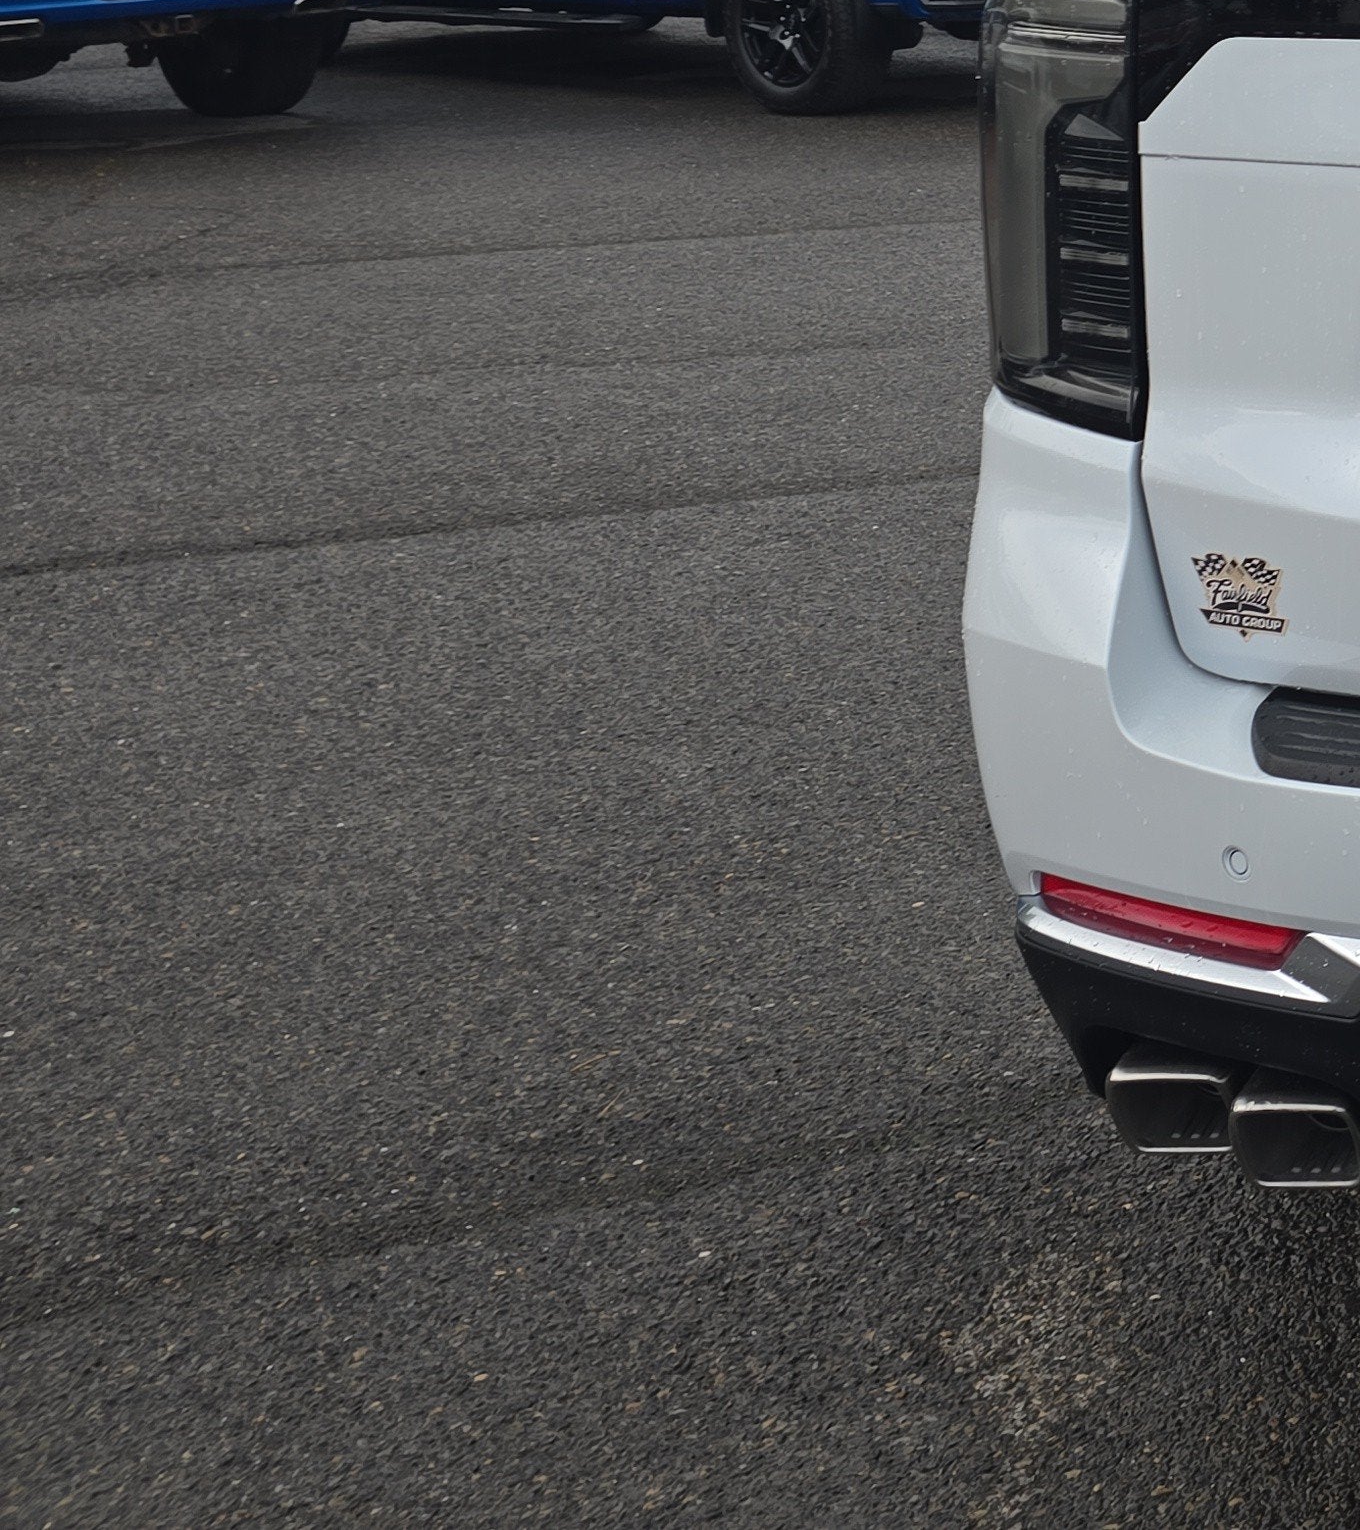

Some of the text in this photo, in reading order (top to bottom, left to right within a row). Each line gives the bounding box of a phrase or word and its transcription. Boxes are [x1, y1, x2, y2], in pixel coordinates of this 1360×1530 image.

[1206, 579, 1272, 612] Fairfield
[1209, 612, 1282, 630] AUTO GROUP
